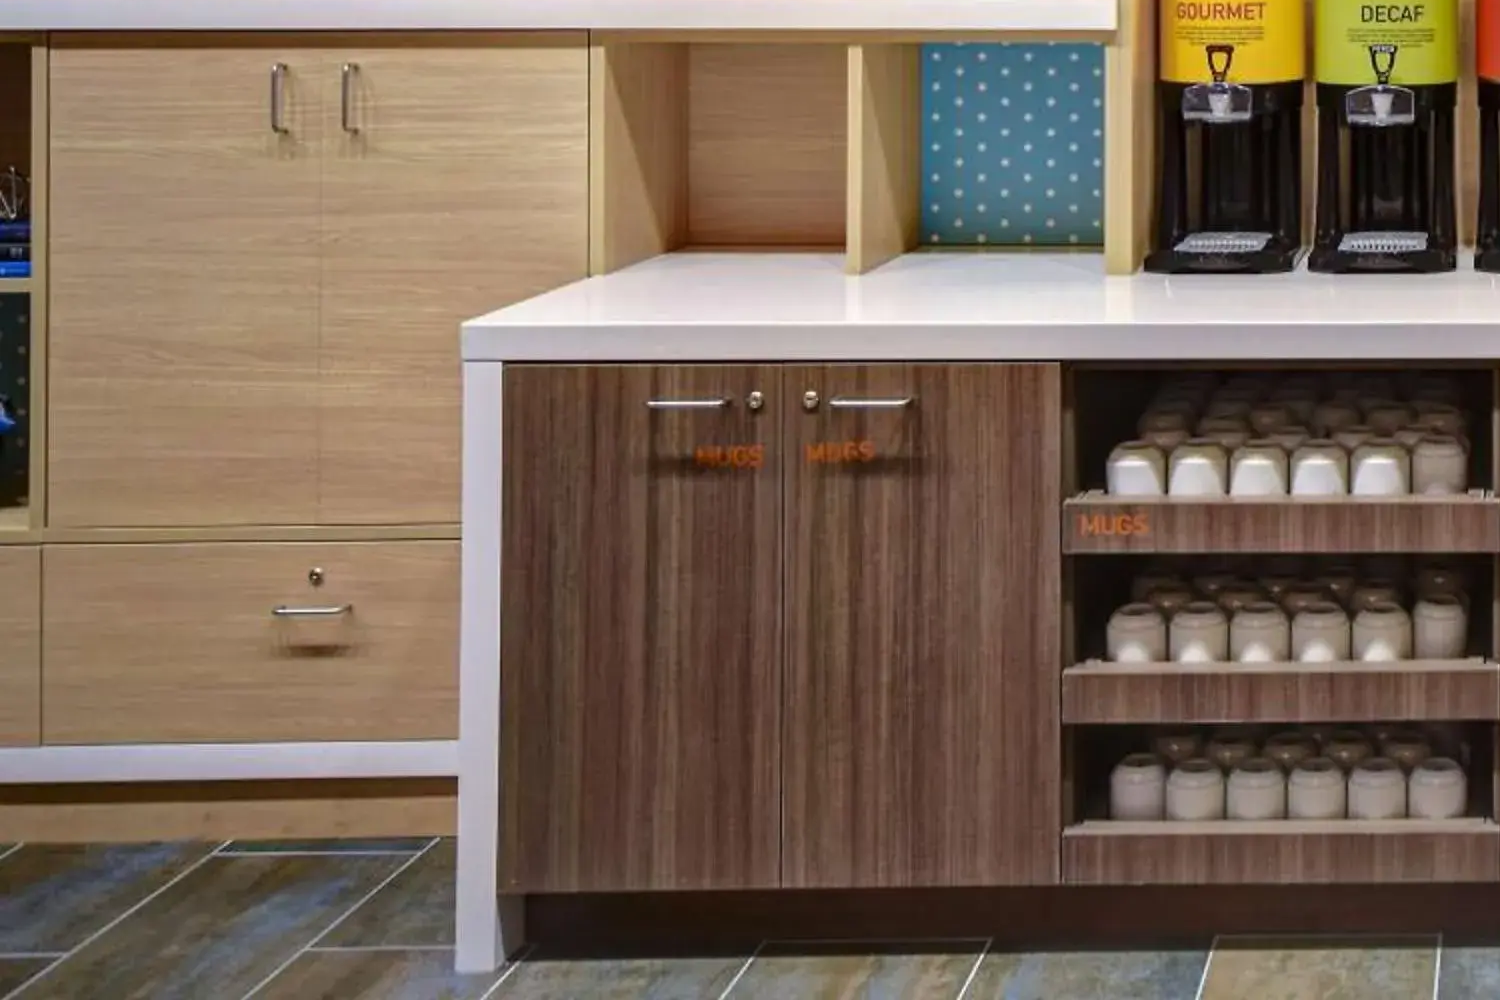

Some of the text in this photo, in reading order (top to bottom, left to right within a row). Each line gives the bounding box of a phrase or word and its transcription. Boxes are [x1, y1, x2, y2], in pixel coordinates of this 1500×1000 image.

[1176, 1, 1266, 20] GOURMET
[1361, 5, 1424, 23] DECAF
[695, 443, 764, 468] MUGS
[805, 441, 876, 463] MUGS
[1079, 513, 1149, 537] MUGS
